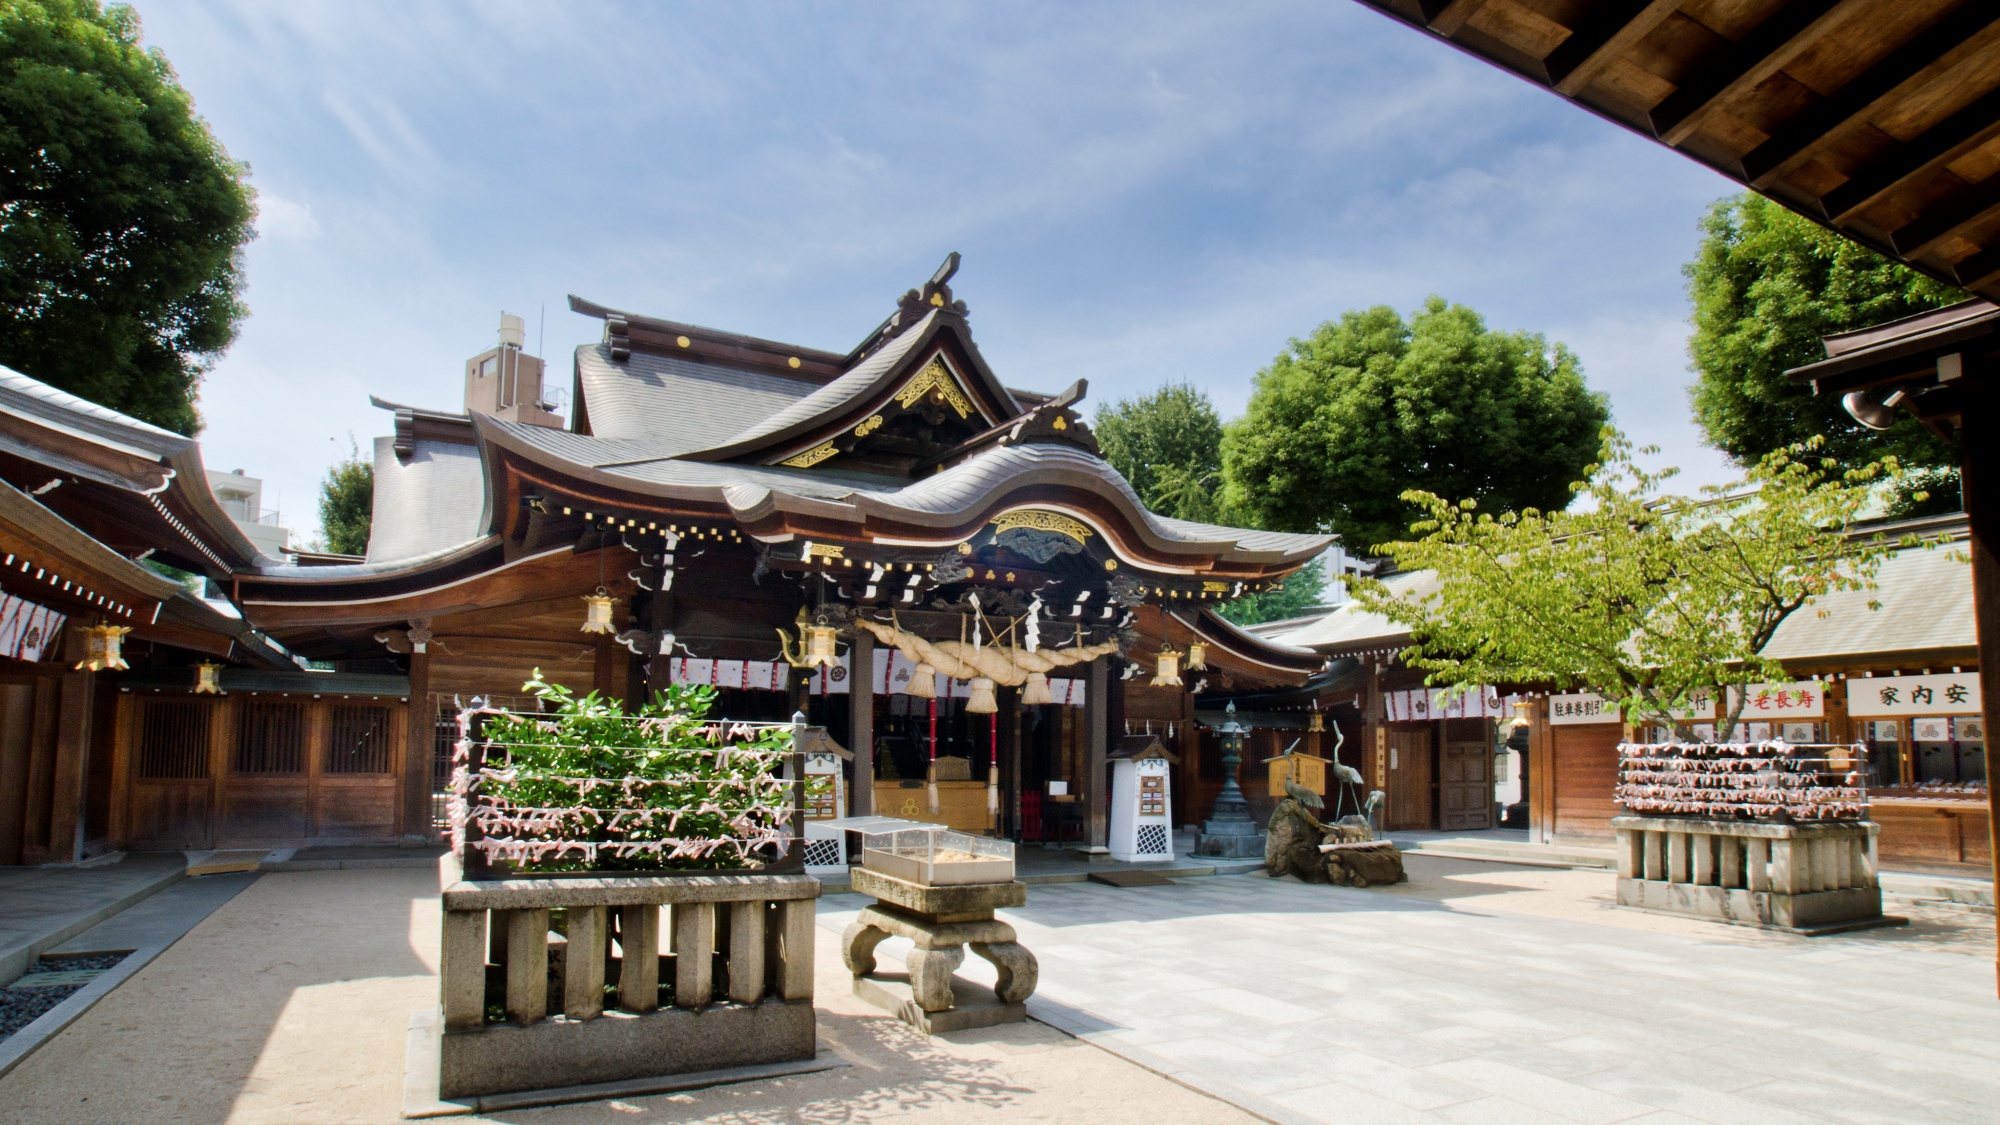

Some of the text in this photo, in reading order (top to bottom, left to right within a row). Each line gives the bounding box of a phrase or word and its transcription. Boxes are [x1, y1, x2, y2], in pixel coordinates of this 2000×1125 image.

[1554, 699, 1613, 717] 駐車券割引
